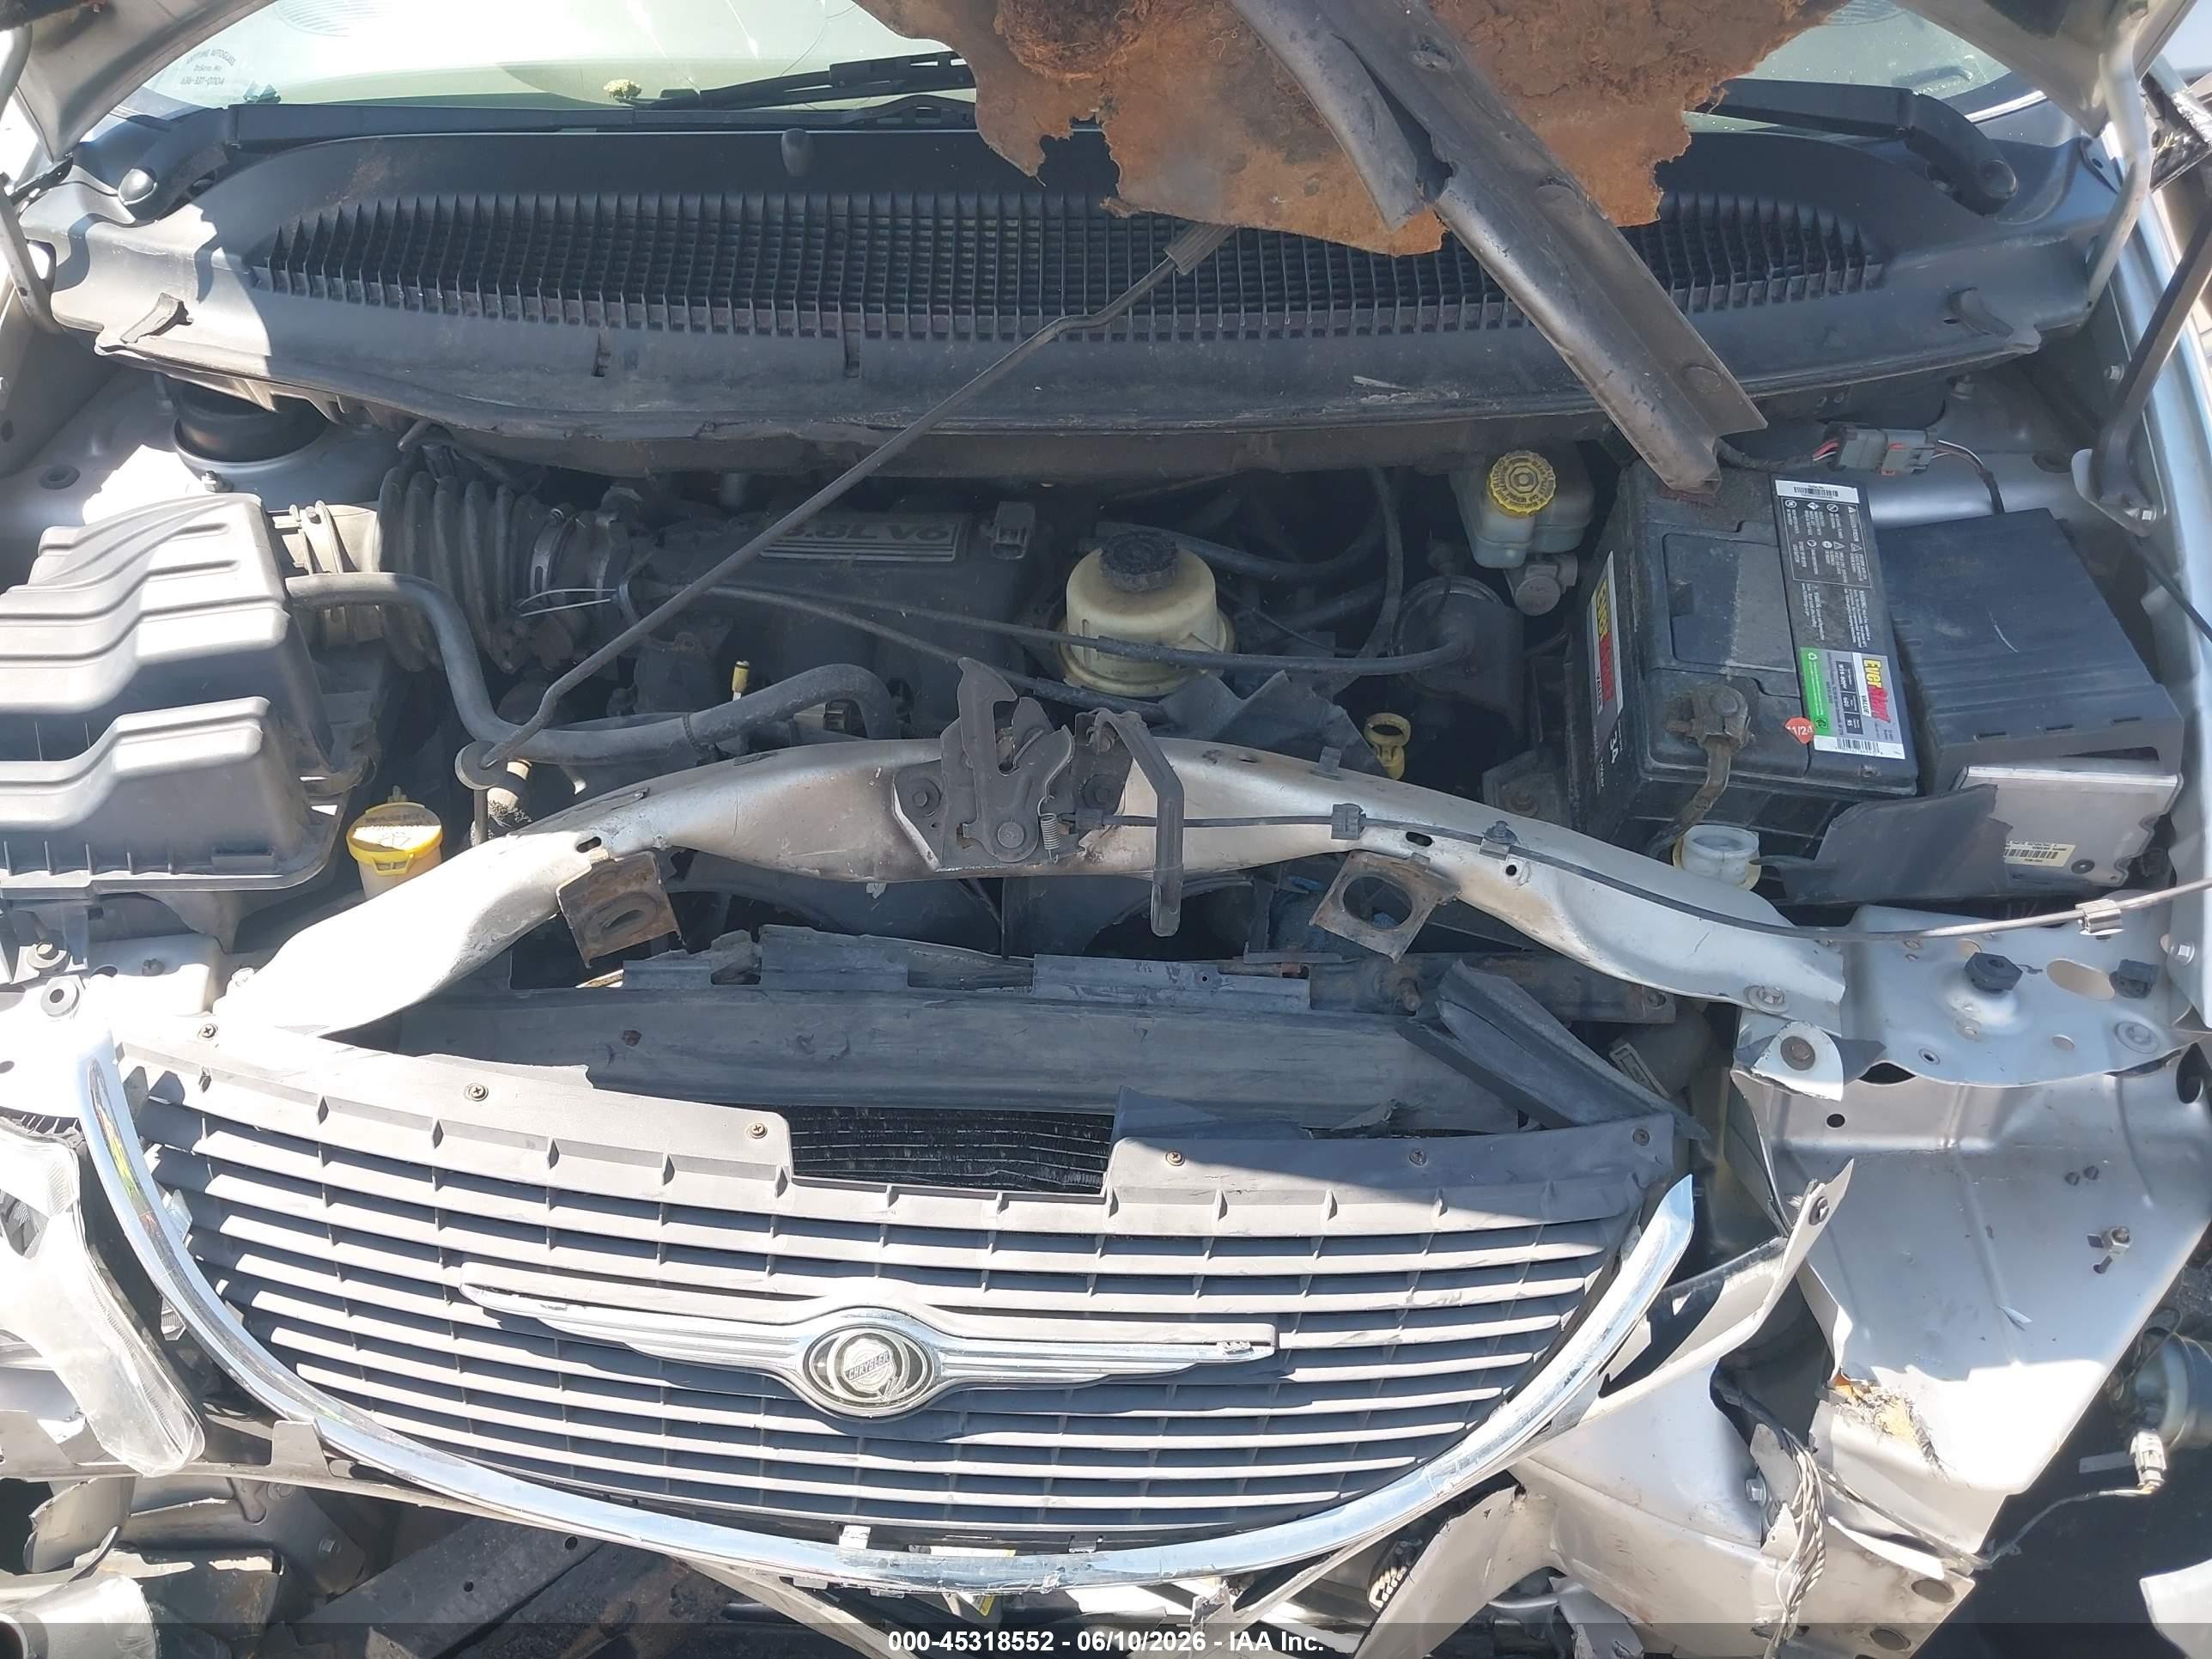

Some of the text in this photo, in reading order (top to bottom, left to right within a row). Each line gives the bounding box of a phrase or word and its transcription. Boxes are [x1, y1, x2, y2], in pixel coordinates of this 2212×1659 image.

[210, 48, 236, 66] AUTOGLASS
[888, 525, 950, 541] V6
[1863, 658, 1891, 723] EverStart
[1860, 695, 1870, 715] VALUE
[1609, 730, 1618, 764] 34
[848, 1351, 890, 1379] CHRYSLER
